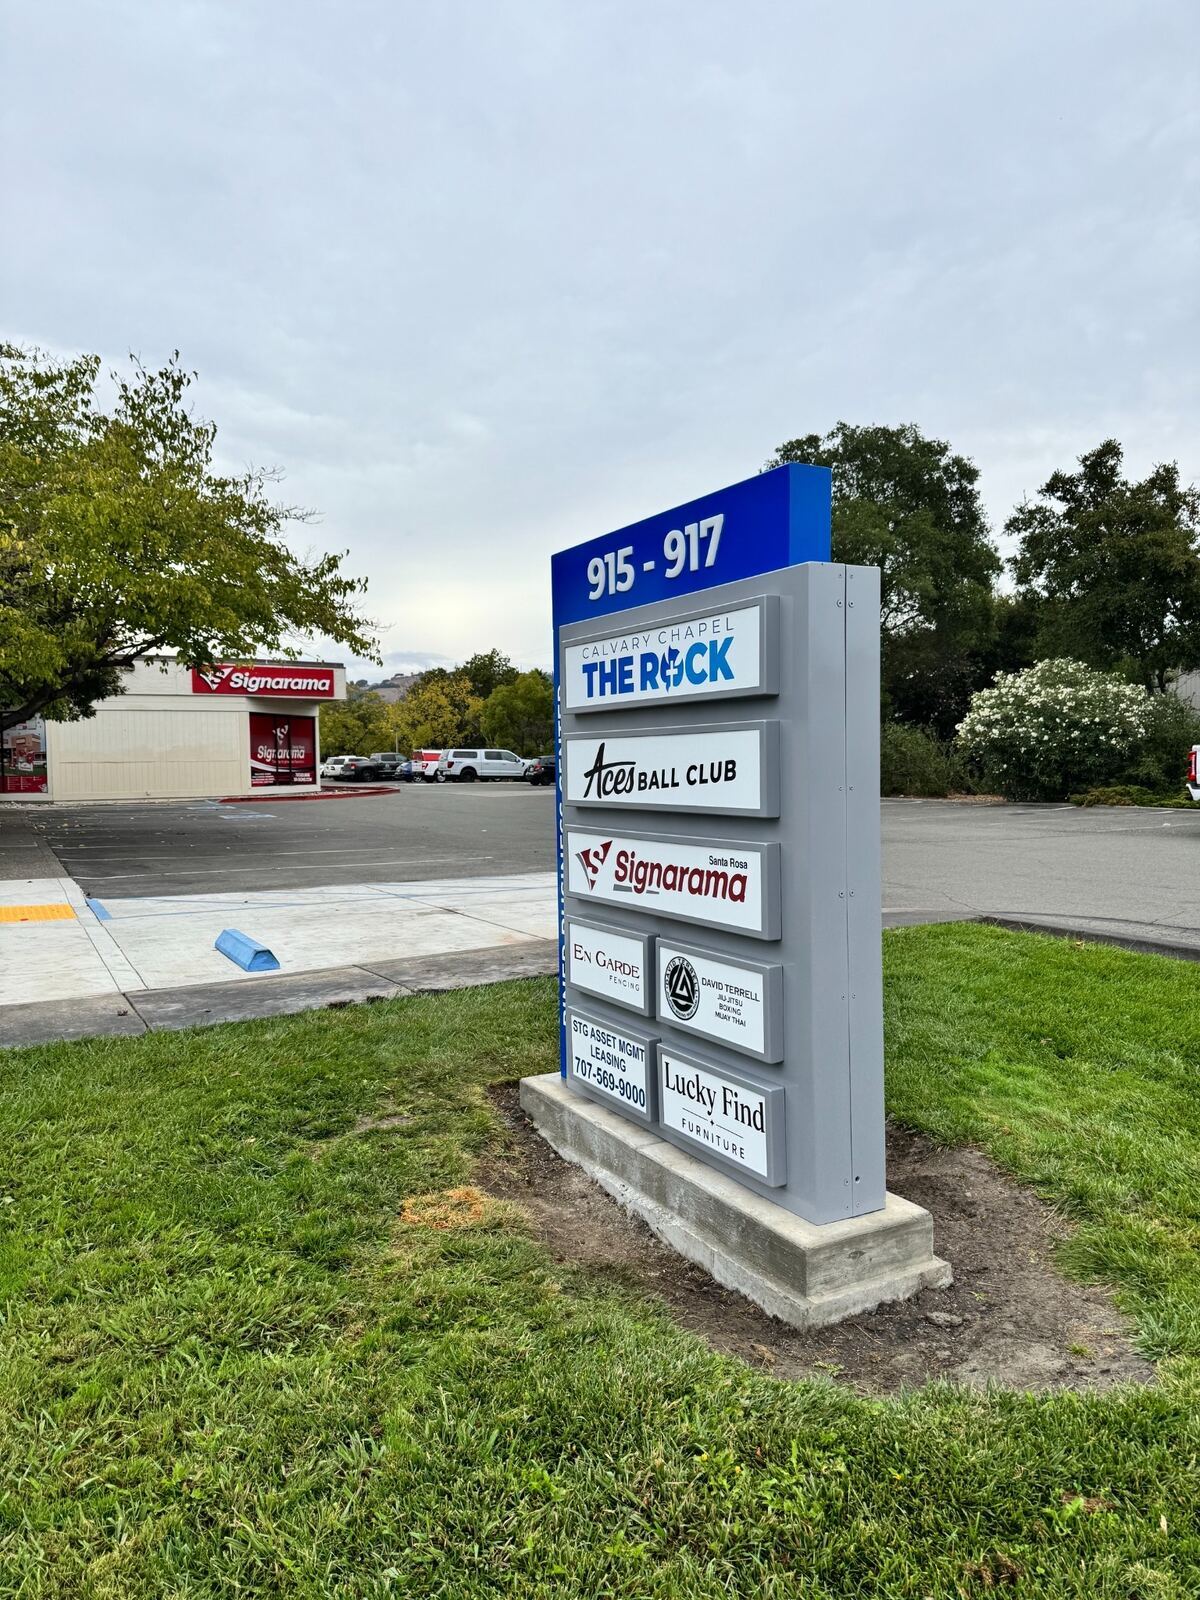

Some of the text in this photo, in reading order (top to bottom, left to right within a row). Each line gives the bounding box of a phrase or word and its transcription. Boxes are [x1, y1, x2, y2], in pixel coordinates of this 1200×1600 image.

[587, 546, 635, 601] 915
[663, 514, 725, 579] 917
[582, 617, 735, 660] CALVARY CHAPEL
[229, 672, 331, 692] Signarama
[582, 656, 635, 698] THE
[584, 743, 736, 799] Aces BALL CLUB
[614, 850, 748, 903] Signarama
[708, 855, 748, 870] Santa Rosa
[609, 974, 640, 992] FENCING
[701, 977, 760, 1002] DAVID TERRELL
[715, 1011, 746, 1027] MUAY THAI
[719, 1003, 742, 1016] BOXING
[572, 1019, 645, 1063] STG ASSET MGMT
[590, 1044, 627, 1072] LEASING
[575, 1056, 646, 1108] 707-569-9000
[665, 1062, 765, 1133] Lucky Find
[682, 1118, 745, 1160] FURNITURE
